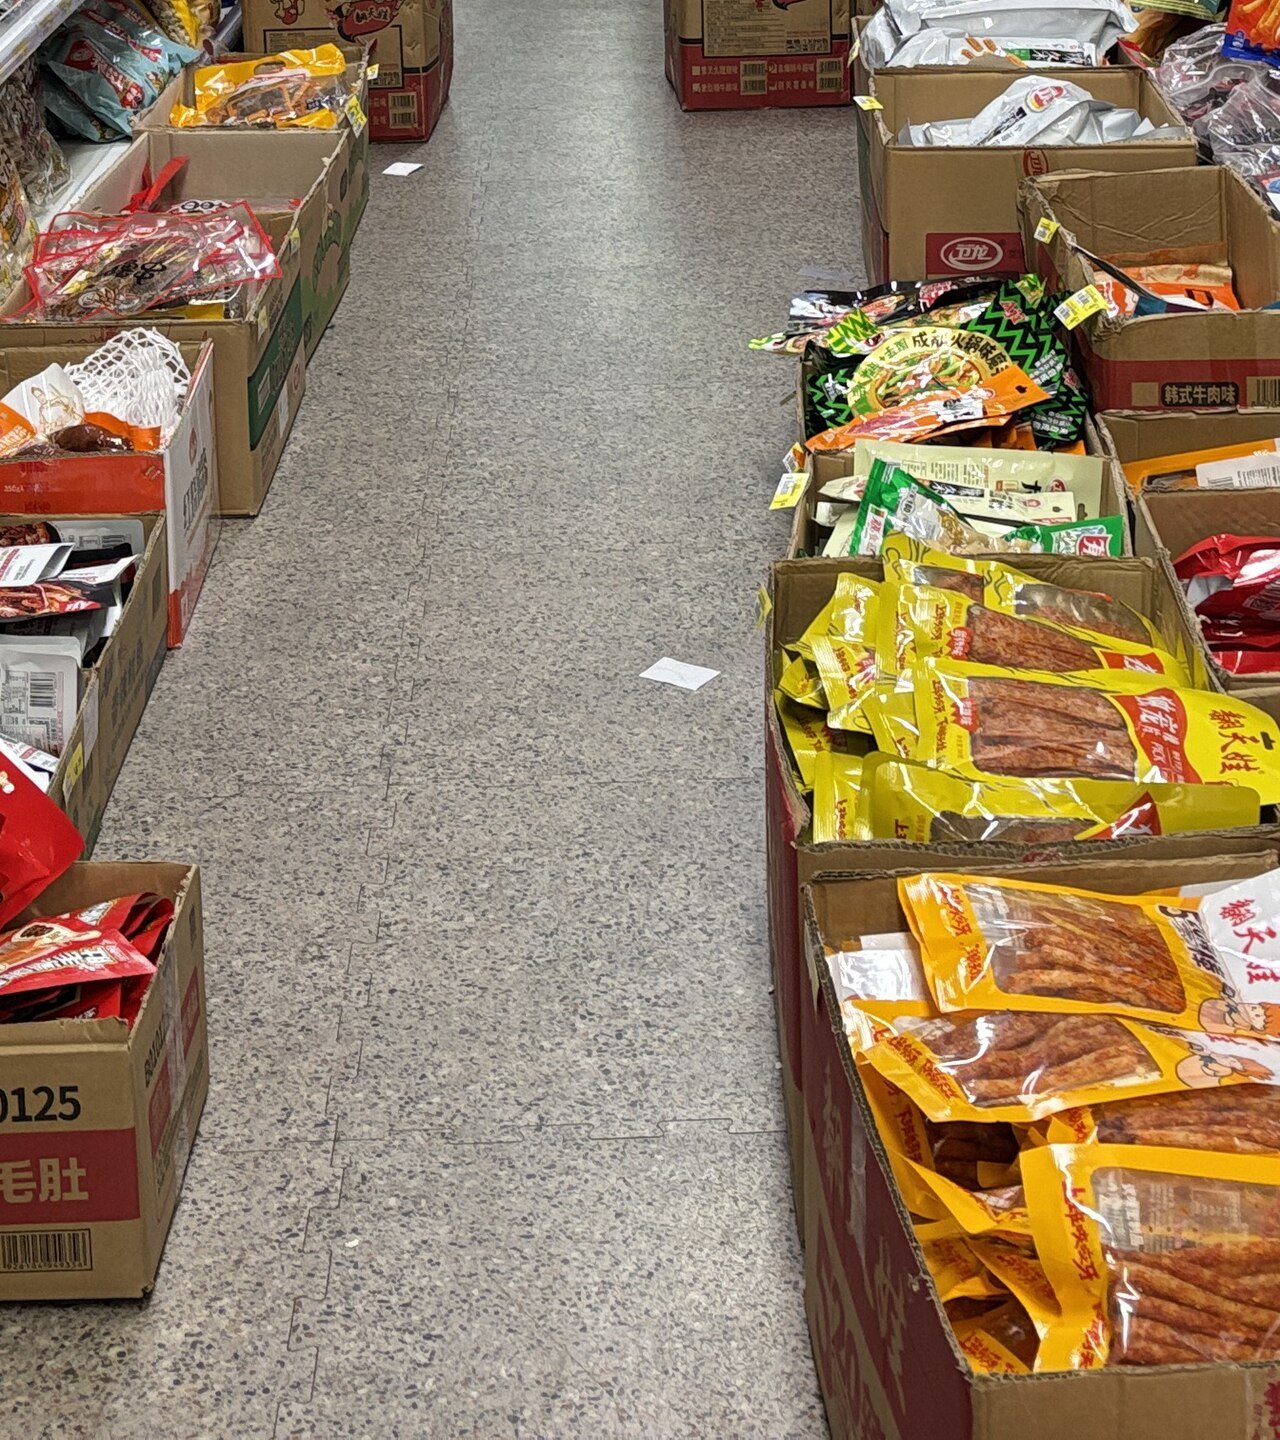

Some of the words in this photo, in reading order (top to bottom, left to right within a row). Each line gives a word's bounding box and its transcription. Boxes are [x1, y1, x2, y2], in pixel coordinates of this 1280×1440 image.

[951, 240, 993, 268] 卫龙
[1163, 382, 1237, 406] 韩式牛肉味
